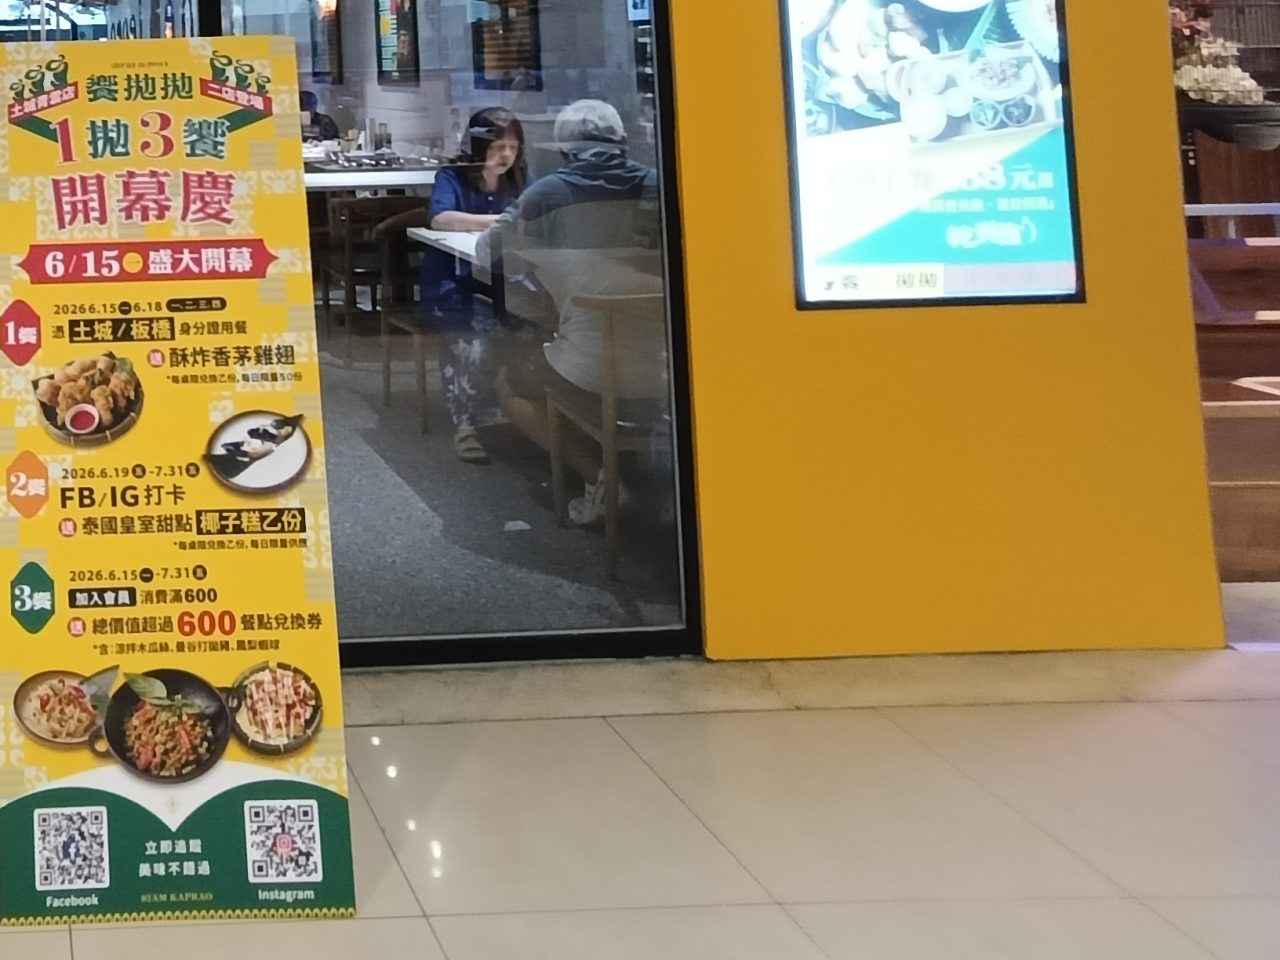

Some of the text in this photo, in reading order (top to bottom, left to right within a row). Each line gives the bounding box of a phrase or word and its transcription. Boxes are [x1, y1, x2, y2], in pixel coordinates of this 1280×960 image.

[50, 168, 237, 231] 開幕慶
[169, 345, 296, 368] 酥炸香茅雞翅
[82, 513, 193, 536] 泰國皇室甜點
[200, 510, 303, 534] 椰子糕乙份
[91, 616, 175, 635] 總價值超過
[177, 609, 237, 637] 600
[240, 612, 323, 631] 餐點兌換券
[46, 894, 99, 907] Facebook
[258, 888, 315, 903] Instagram
